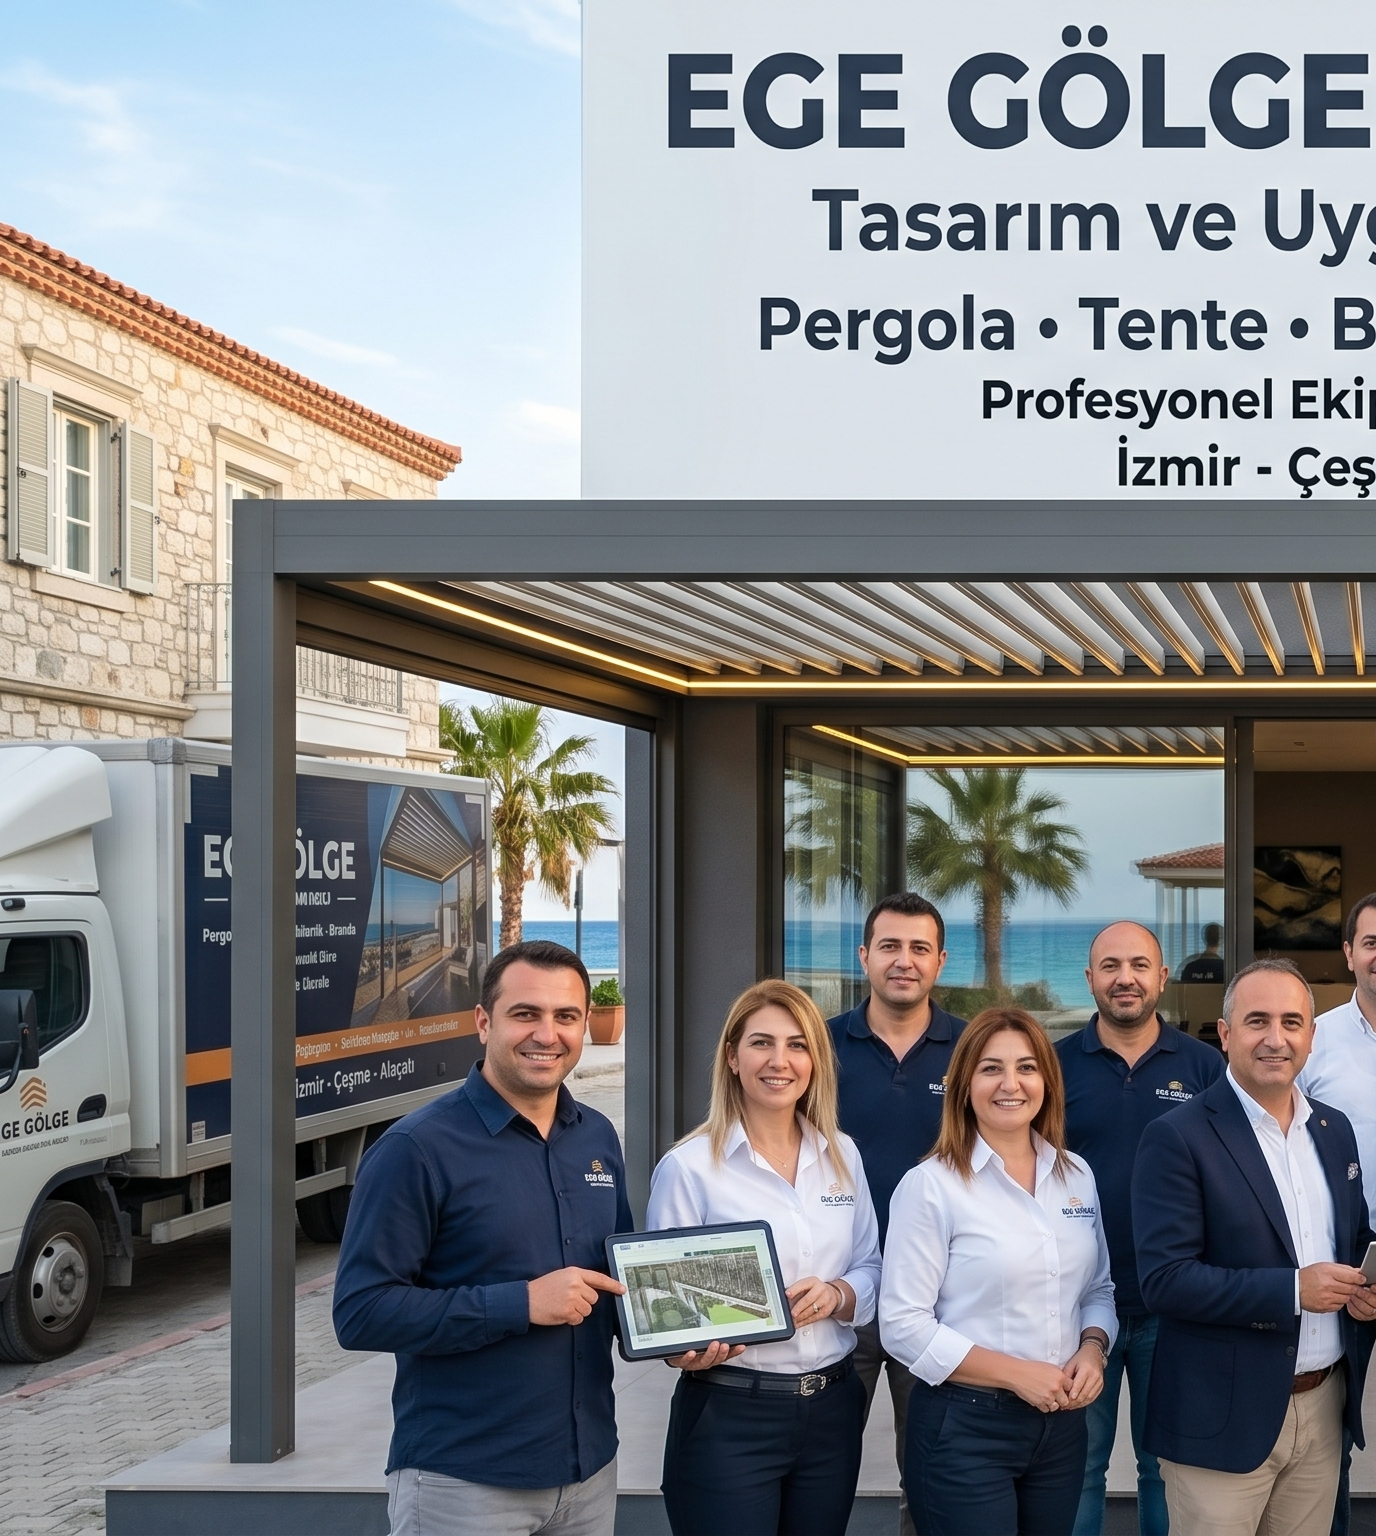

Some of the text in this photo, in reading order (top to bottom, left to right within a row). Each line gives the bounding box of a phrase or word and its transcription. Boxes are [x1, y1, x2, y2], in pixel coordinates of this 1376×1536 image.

[668, 52, 905, 151] EGE
[946, 24, 1371, 151] GÖLGE
[811, 188, 1120, 253] Tasarım
[1145, 203, 1236, 253] ve
[760, 293, 1015, 366] Pergola
[1078, 297, 1268, 351] Tente
[982, 377, 1273, 431] Profesyonel
[1117, 434, 1241, 487] İzmir
[203, 928, 231, 945] Pergo
[329, 923, 356, 936] Branda
[333, 1070, 370, 1094] Çeşme
[379, 1057, 414, 1080] Alaçatı
[1, 1110, 68, 1139] GE GÖLGE
